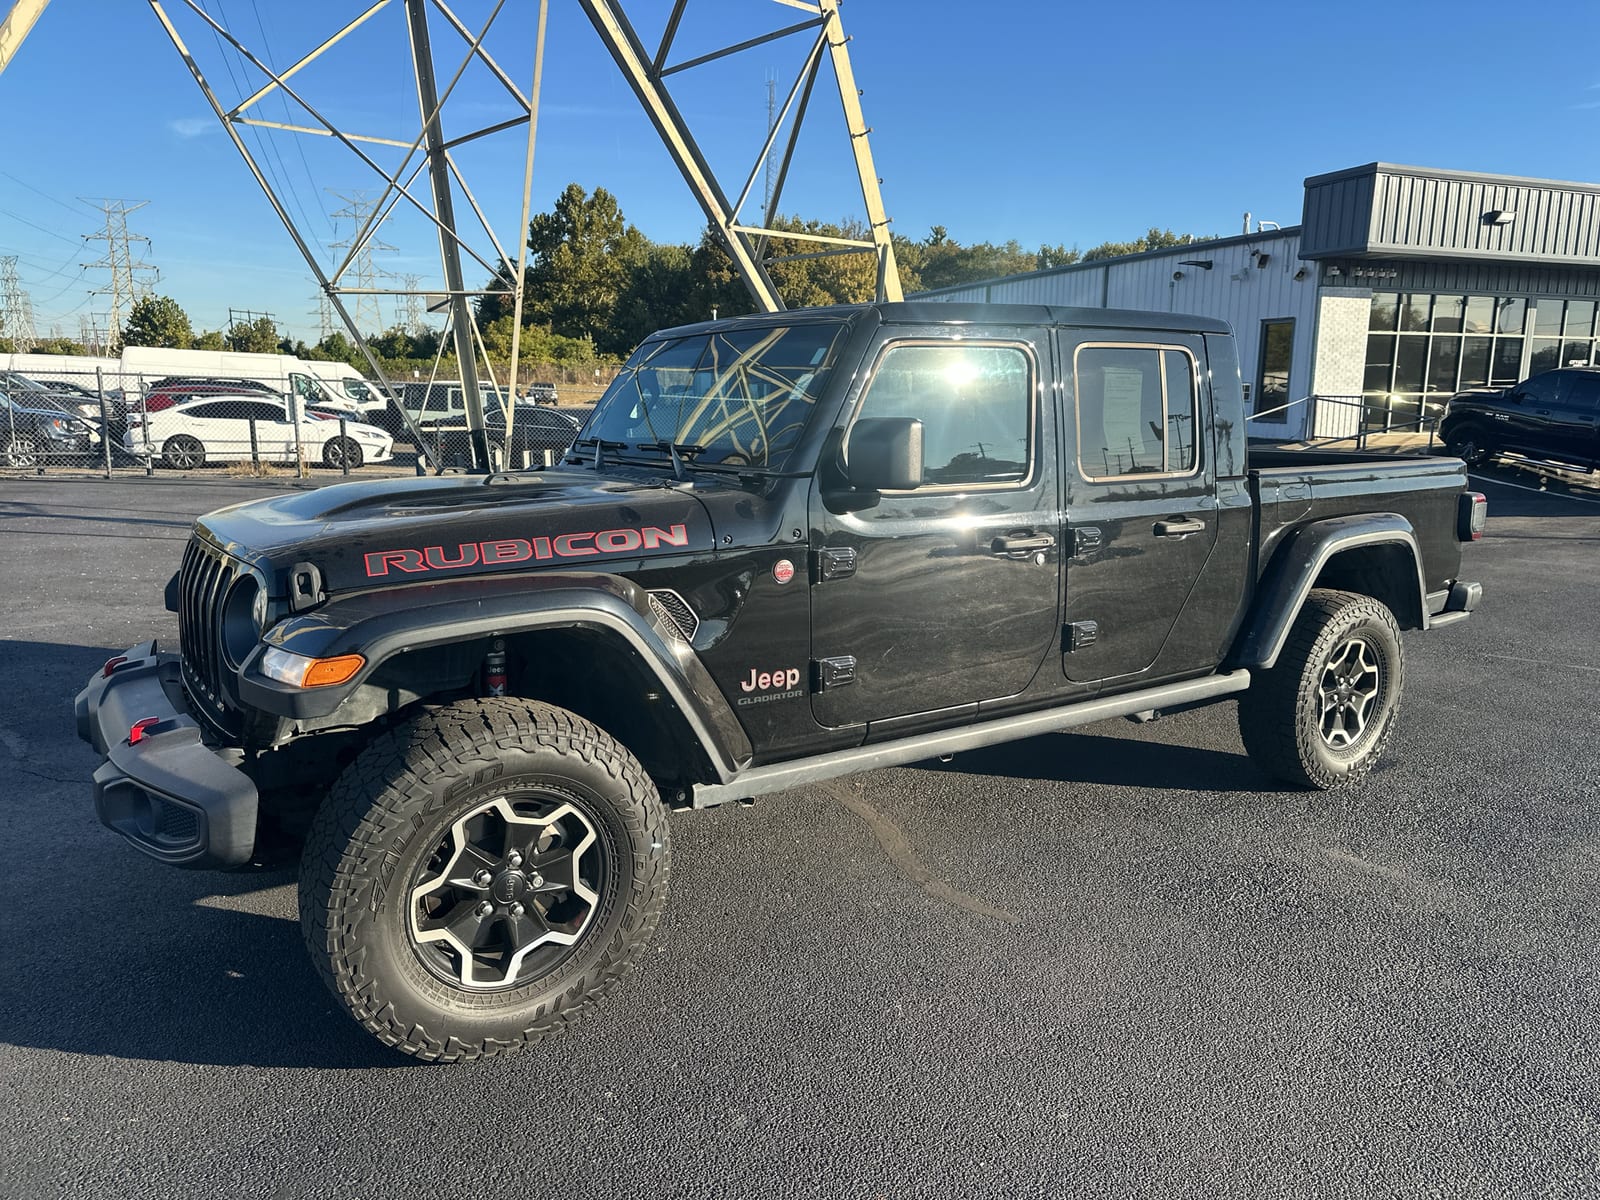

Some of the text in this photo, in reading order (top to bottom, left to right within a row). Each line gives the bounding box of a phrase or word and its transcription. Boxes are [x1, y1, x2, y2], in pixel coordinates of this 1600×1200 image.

[363, 524, 689, 577] RUBICON
[740, 667, 800, 692] Jeep
[737, 690, 804, 705] GLADIATOR
